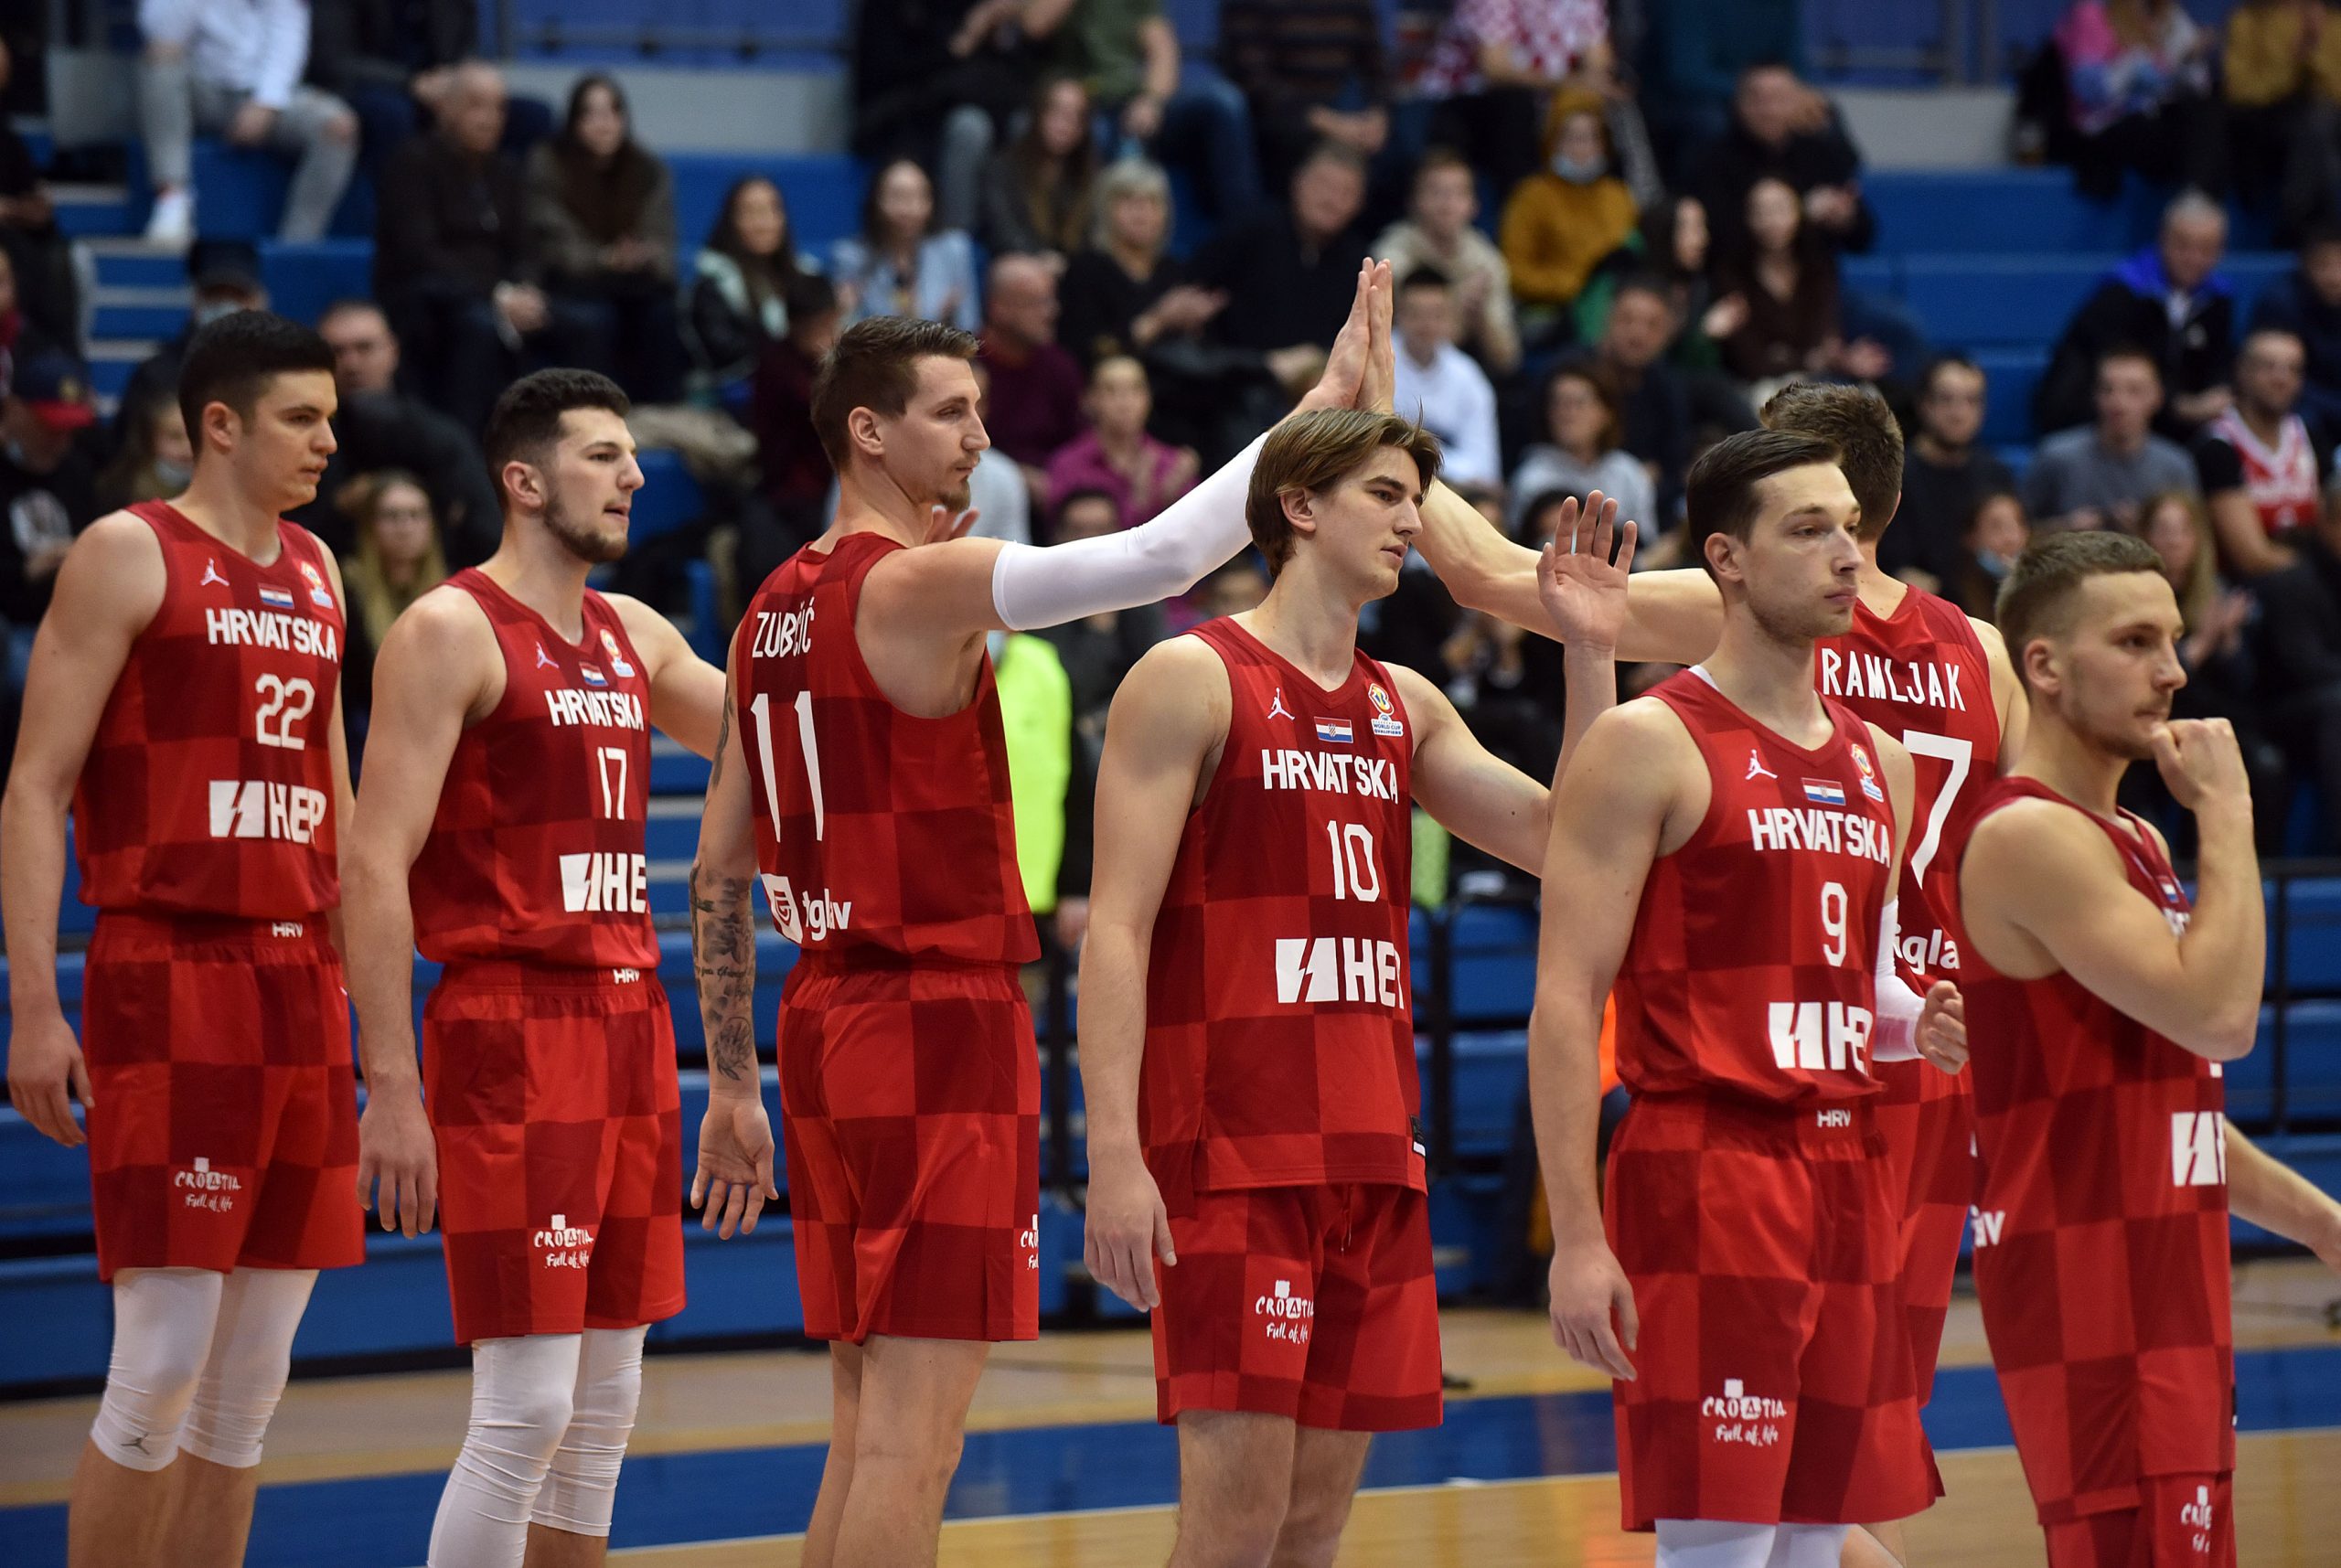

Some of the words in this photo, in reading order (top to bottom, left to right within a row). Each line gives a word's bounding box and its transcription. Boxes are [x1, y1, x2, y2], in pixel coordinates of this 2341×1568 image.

[205, 607, 338, 664] HRVATSKA
[1821, 647, 1966, 712] RAMLJAK
[254, 673, 315, 751] 22
[544, 688, 645, 732] HRVATSKA
[597, 746, 627, 820] 17
[750, 689, 824, 844] 11
[1261, 749, 1398, 805] HRVATSKA
[268, 781, 327, 846] HEP
[1747, 807, 1891, 869] HRVATSKA
[1903, 729, 1973, 891] 7
[602, 852, 647, 913] HE
[1326, 819, 1381, 902] 10
[272, 922, 304, 938] HRV
[1820, 881, 1848, 968] 9
[613, 967, 640, 985] HRV
[1817, 1109, 1852, 1128] HRV
[175, 1170, 242, 1190] CROATIA
[185, 1193, 208, 1208] Full
[534, 1228, 594, 1248] CROATIA
[546, 1251, 568, 1268] Full
[1267, 1322, 1287, 1339] Full
[1702, 1396, 1787, 1420] CROATIA
[1716, 1424, 1743, 1442] Full
